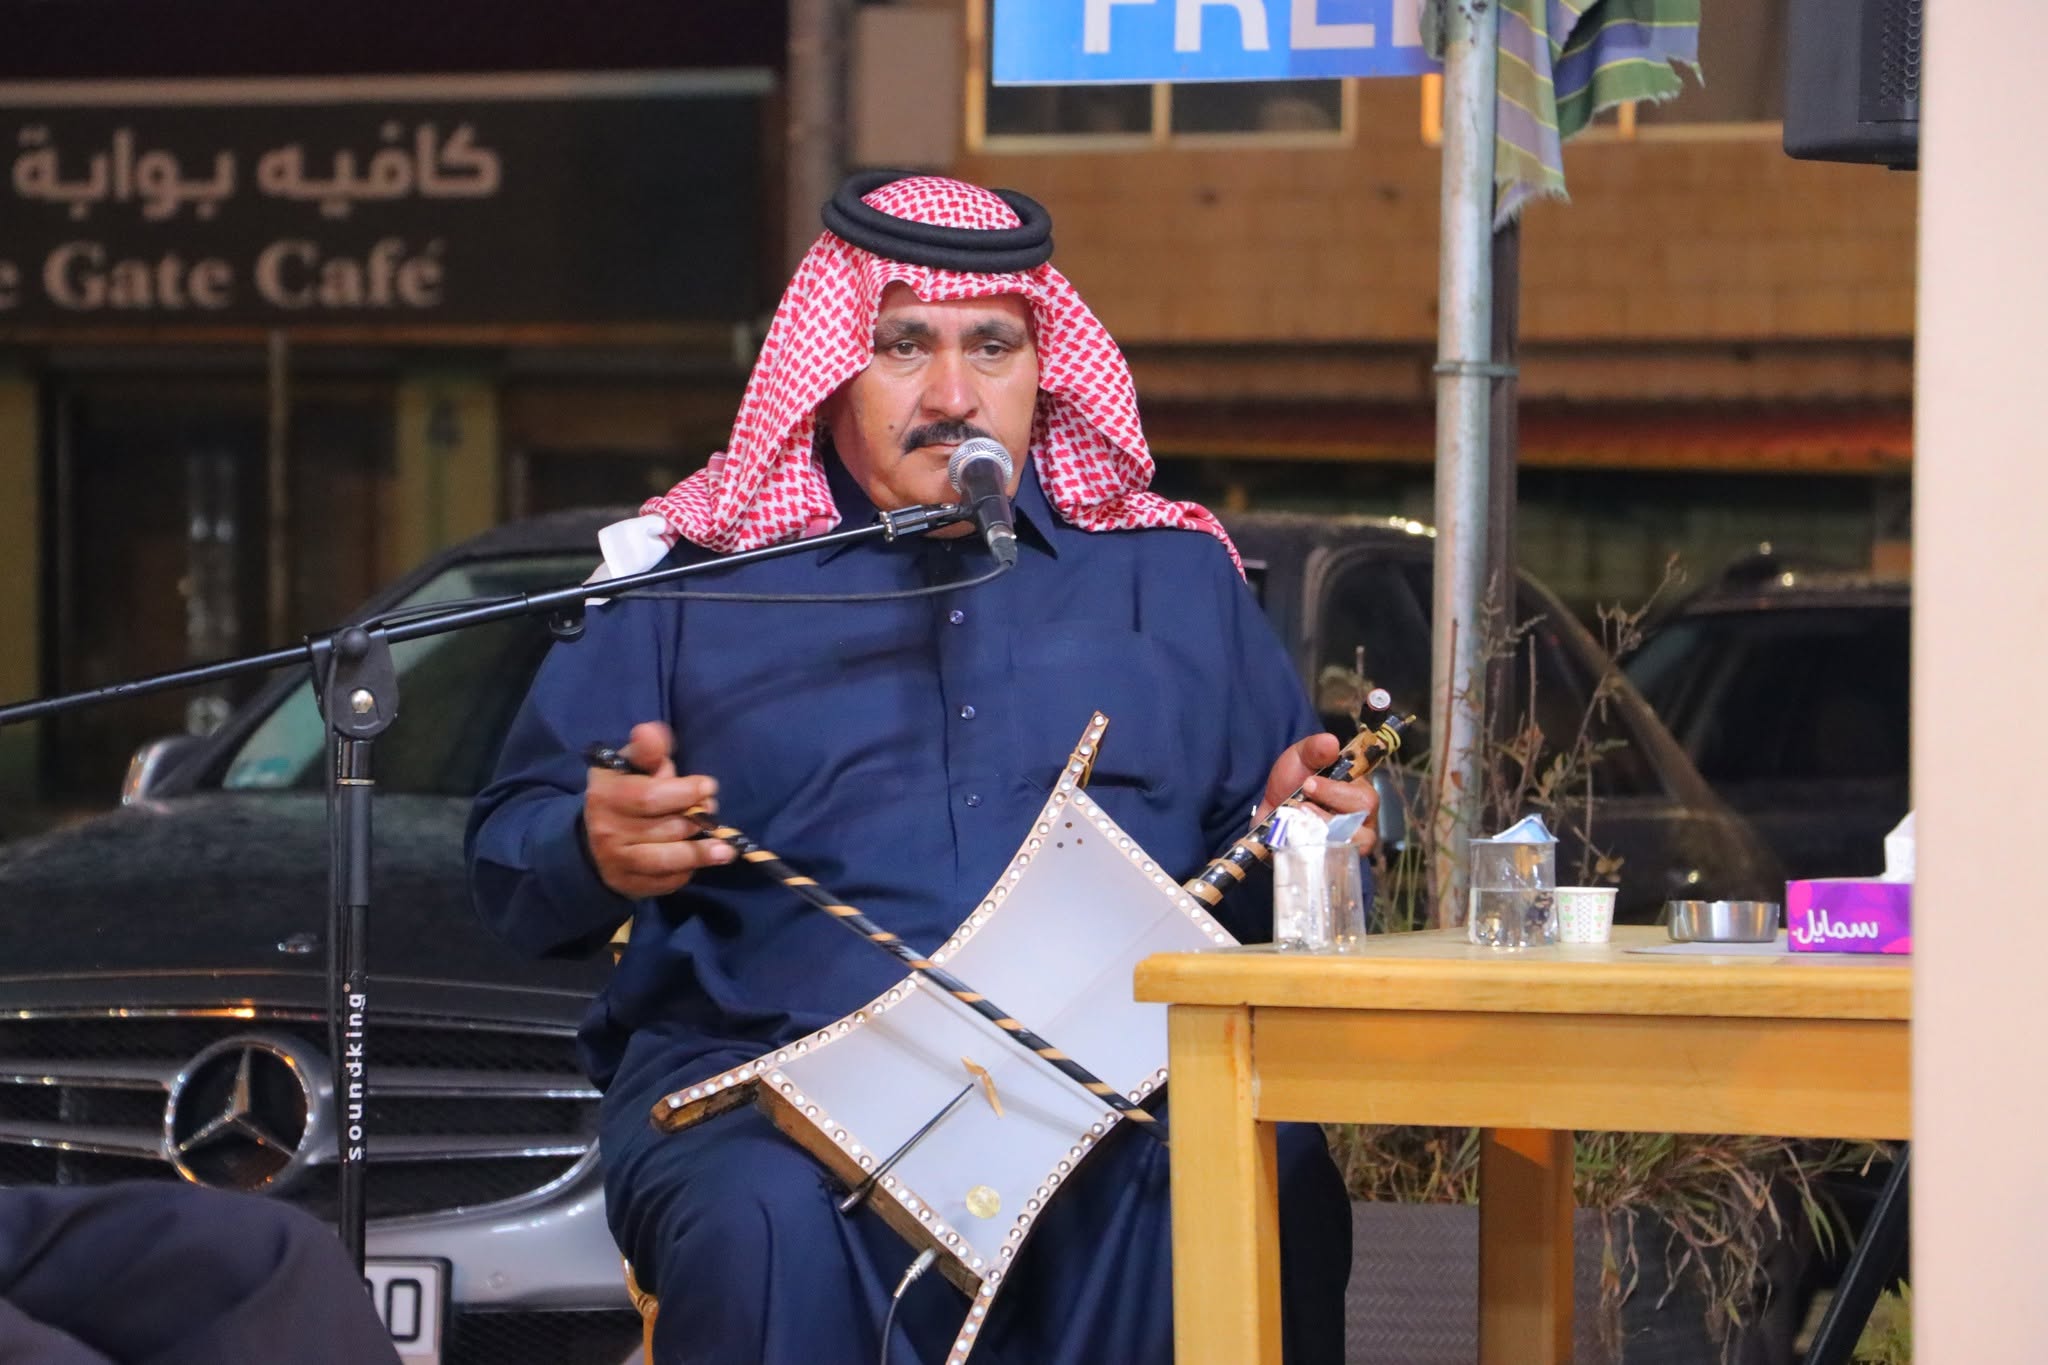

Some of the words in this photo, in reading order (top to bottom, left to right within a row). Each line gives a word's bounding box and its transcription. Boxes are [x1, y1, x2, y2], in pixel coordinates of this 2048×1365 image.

[11, 125, 237, 220] بوابة
[255, 121, 501, 219] كافيه
[42, 242, 235, 310] Gate
[254, 239, 446, 309] Café
[1791, 908, 1880, 945] سمايل
[345, 993, 366, 1161] soundking
